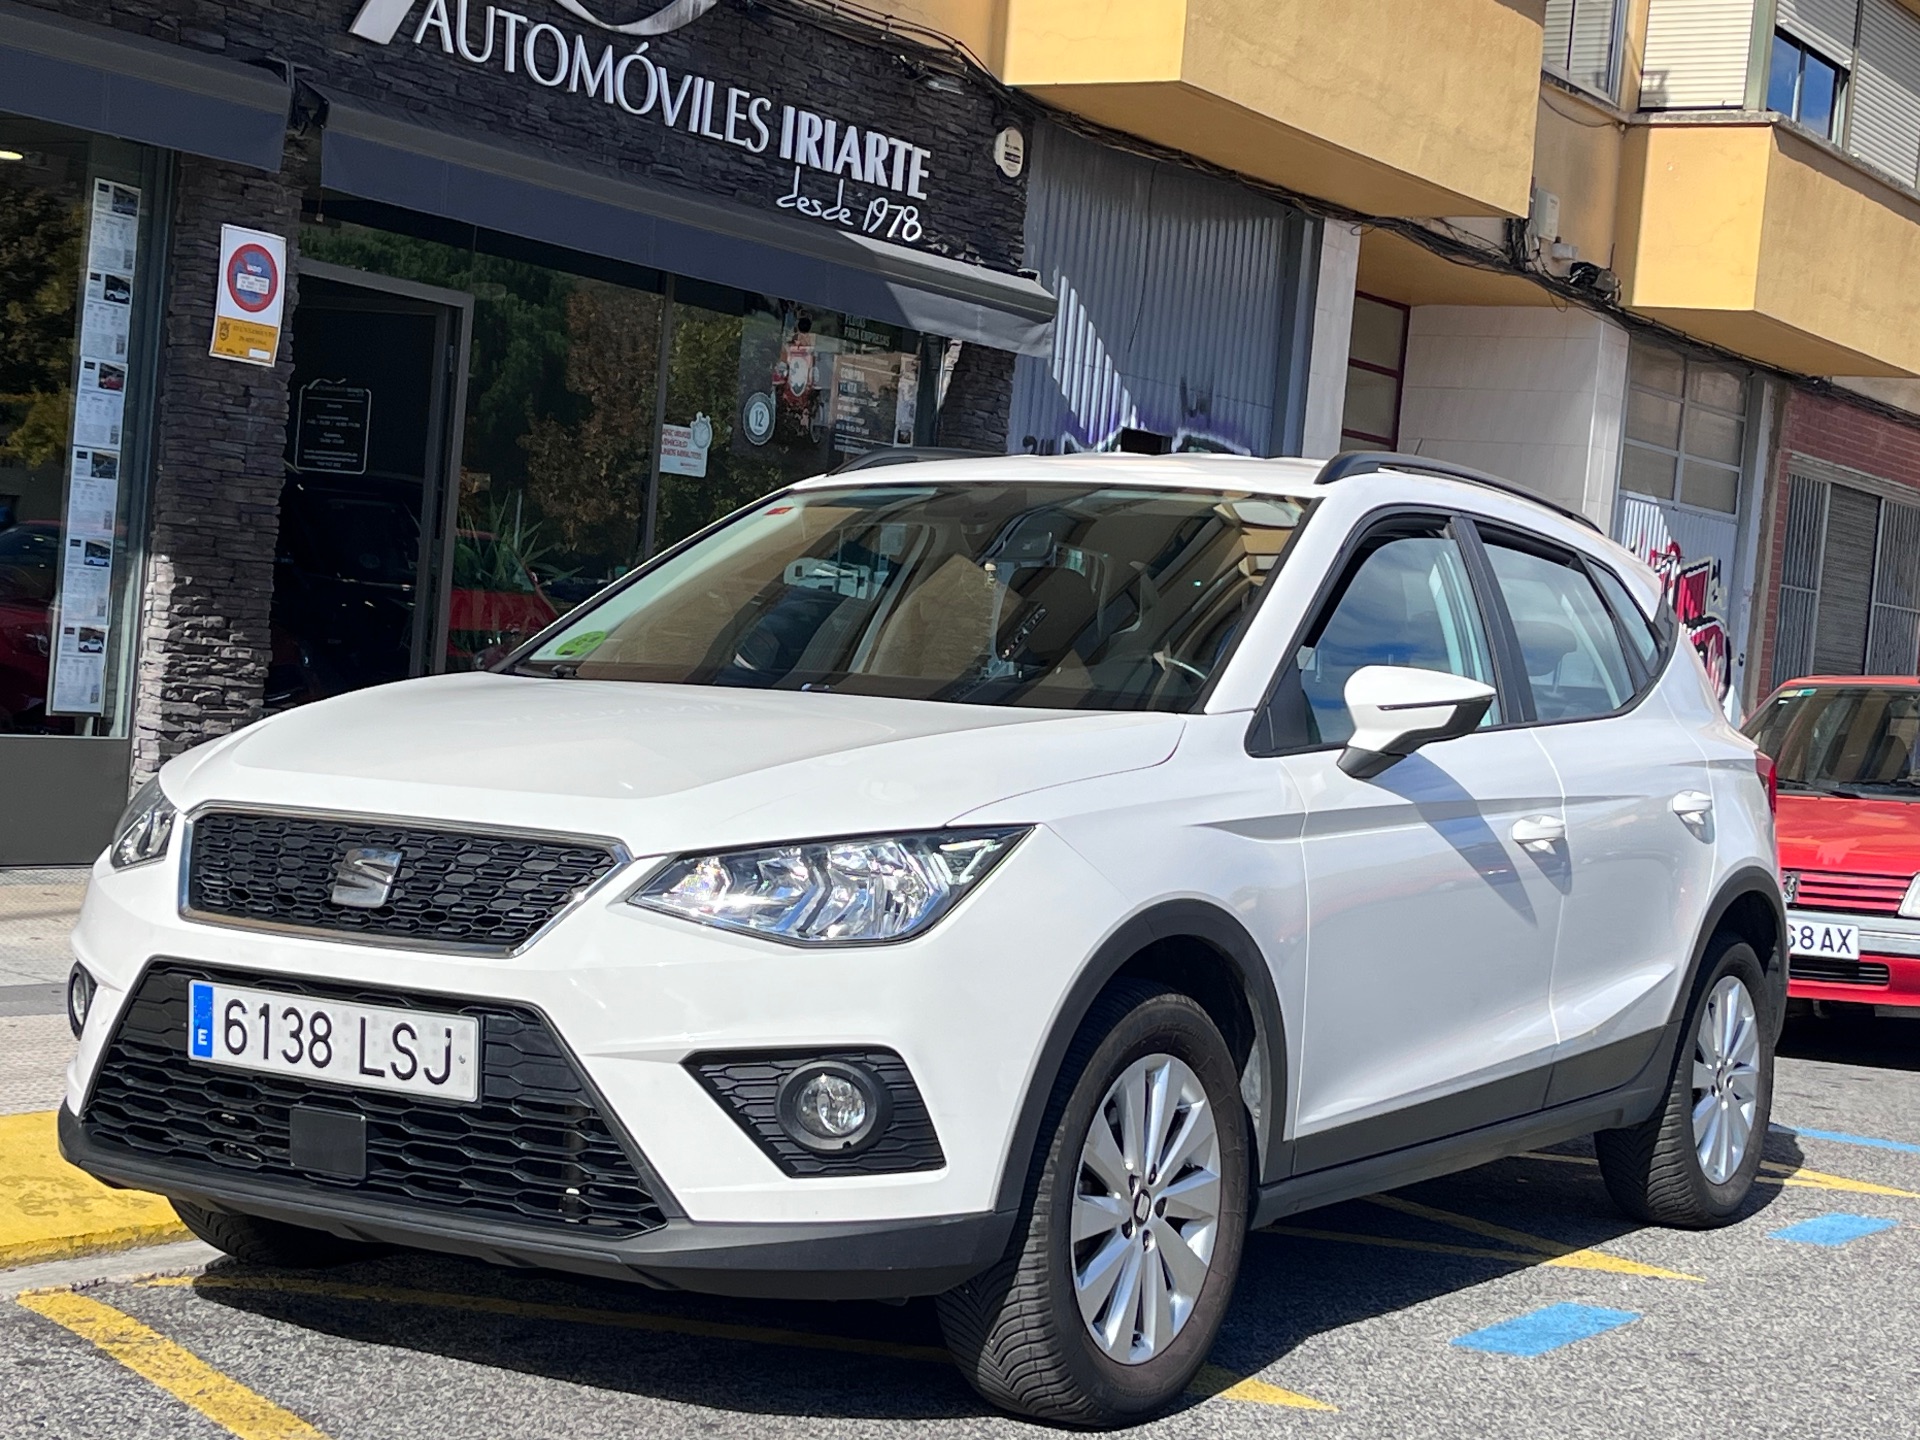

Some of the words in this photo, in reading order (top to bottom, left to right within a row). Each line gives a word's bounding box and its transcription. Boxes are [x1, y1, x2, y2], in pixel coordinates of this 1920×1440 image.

[412, 0, 772, 153] AUTOMÓVILES
[779, 105, 932, 200] IRIARTE
[776, 165, 854, 226] desde
[862, 197, 922, 242] 1978
[755, 410, 765, 428] 12
[198, 1029, 208, 1046] E
[224, 999, 333, 1068] 6138
[359, 1017, 453, 1085] LSJ
